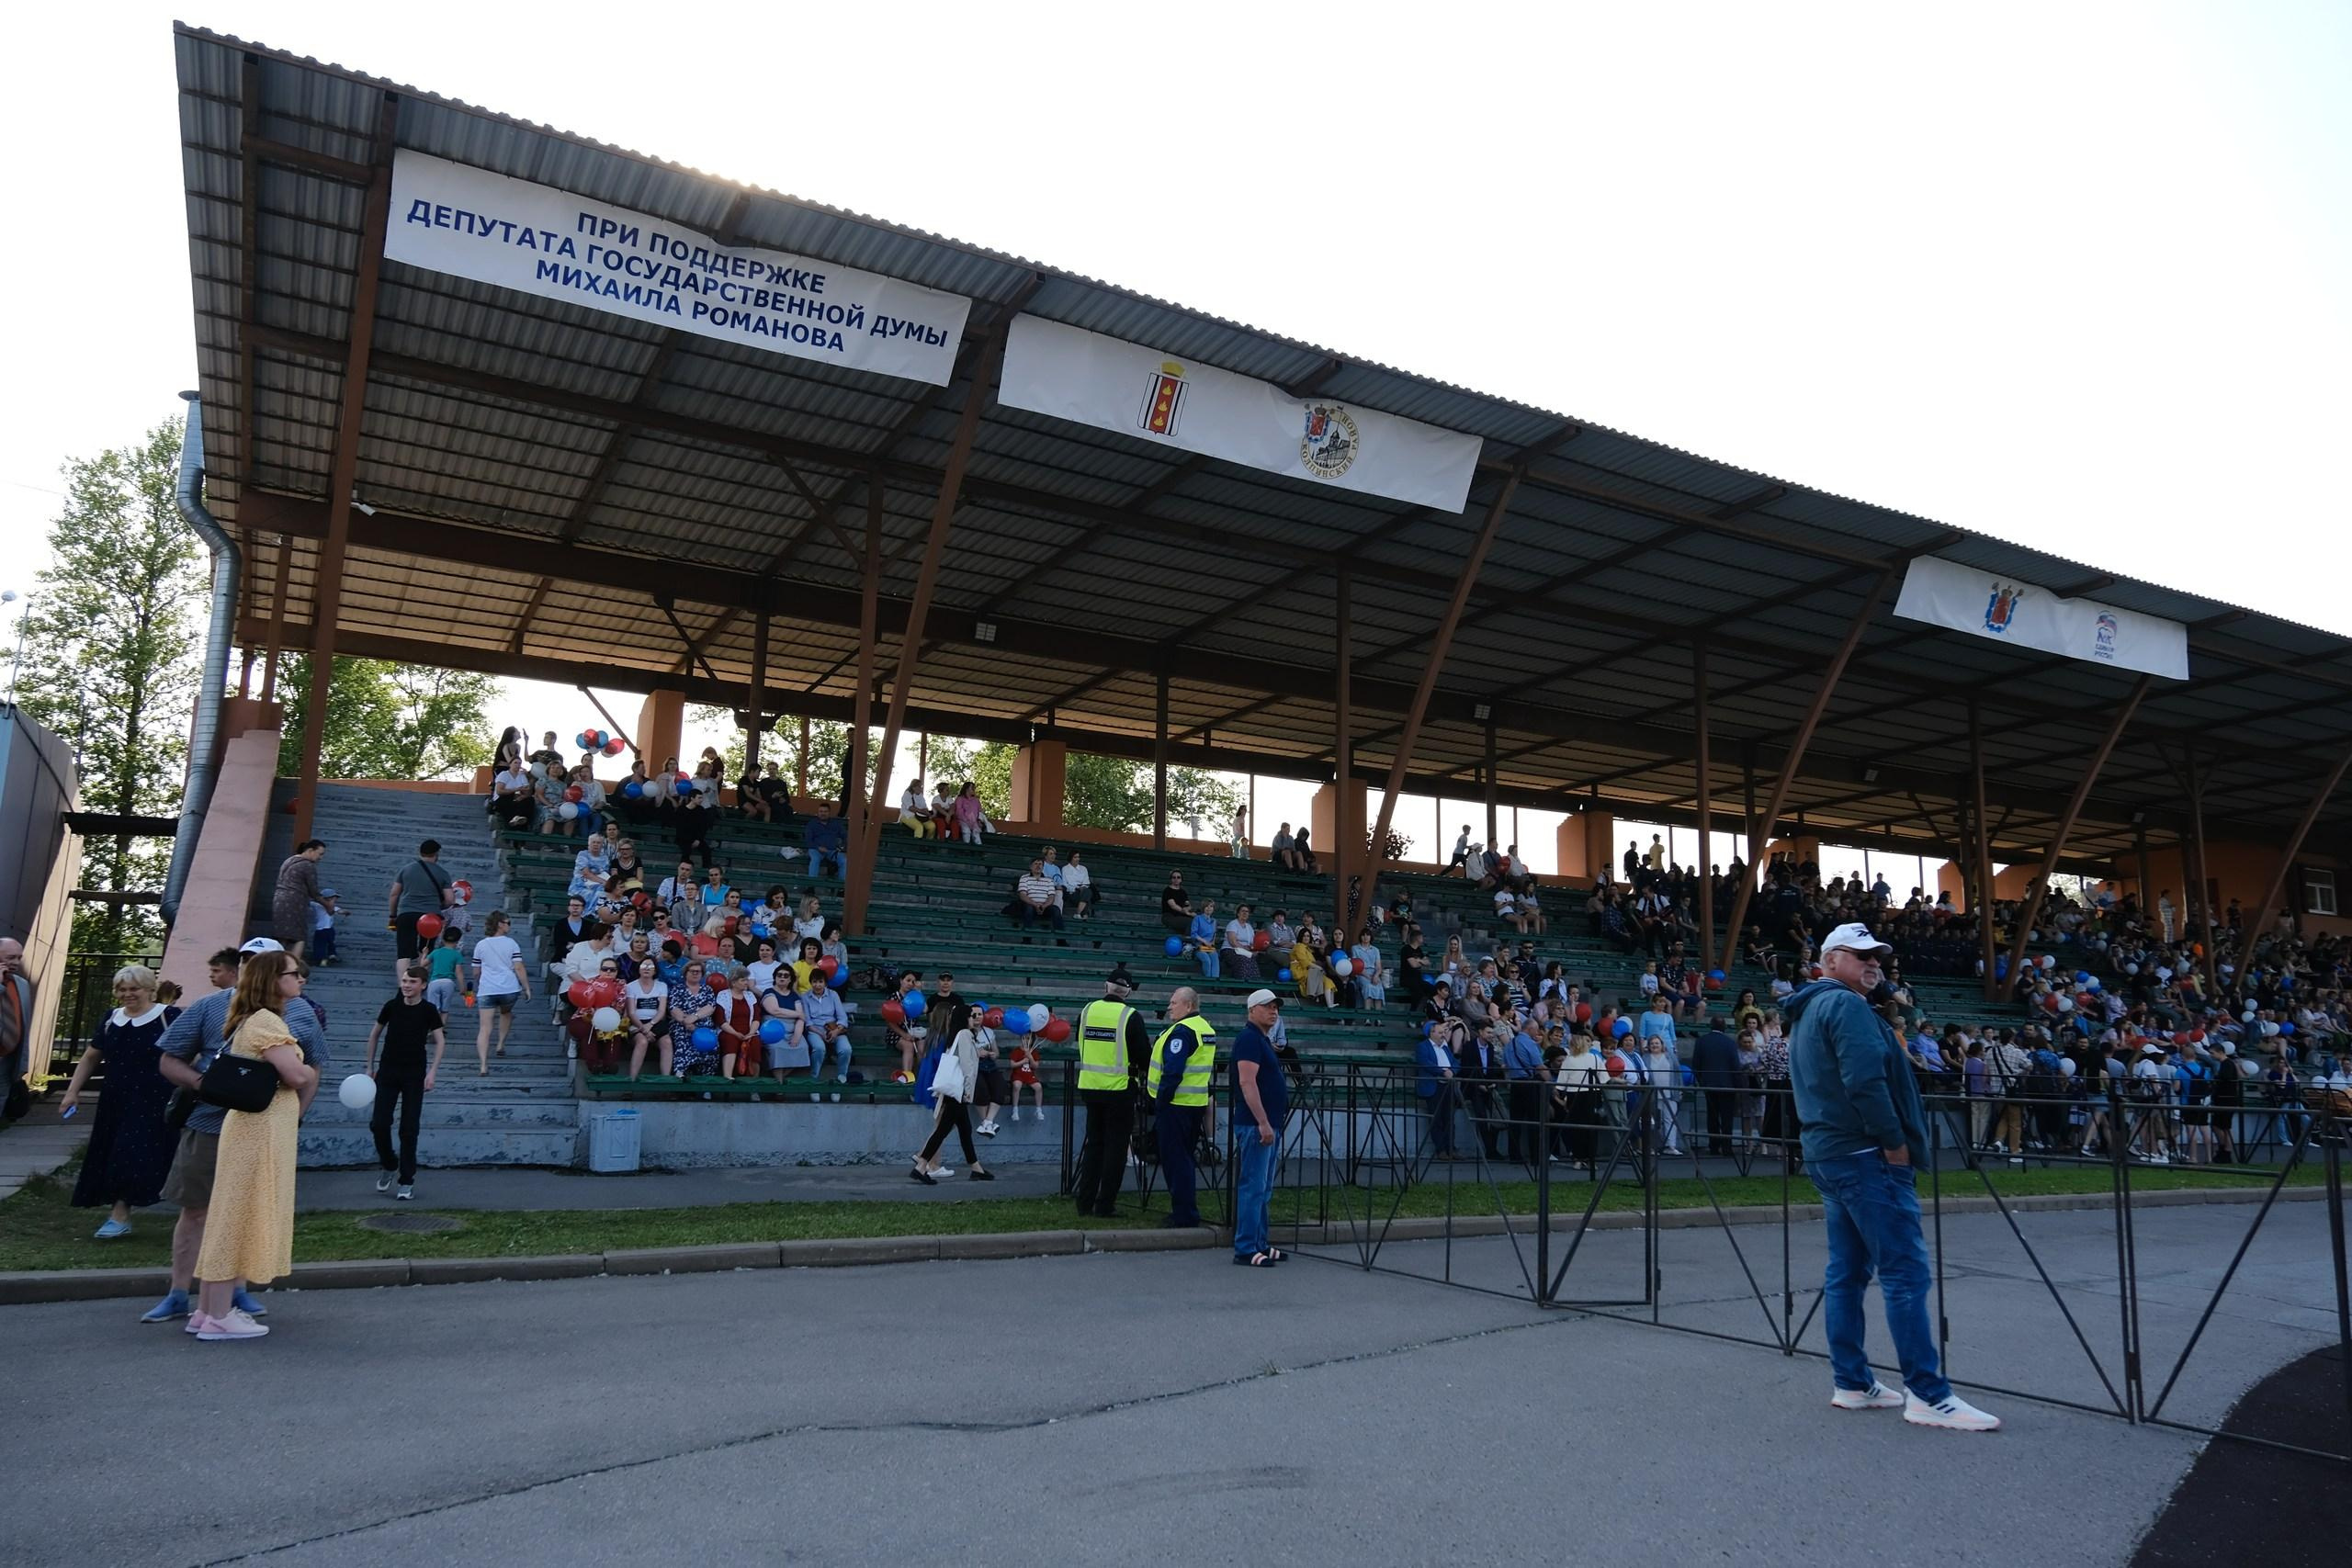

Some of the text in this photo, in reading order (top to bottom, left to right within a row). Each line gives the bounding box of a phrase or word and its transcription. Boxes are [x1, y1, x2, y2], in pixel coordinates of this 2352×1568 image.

[407, 199, 948, 347] ДЕПУТАТА ГОСУДАРСТВЕННОЙ ДУМЫ
[577, 212, 826, 294] ПРИ ПОДДЕРЖКЕ
[536, 259, 844, 353] МИХАИЛА РОМАНОВА
[1302, 443, 1353, 478] КОЛПИНСКИЙ
